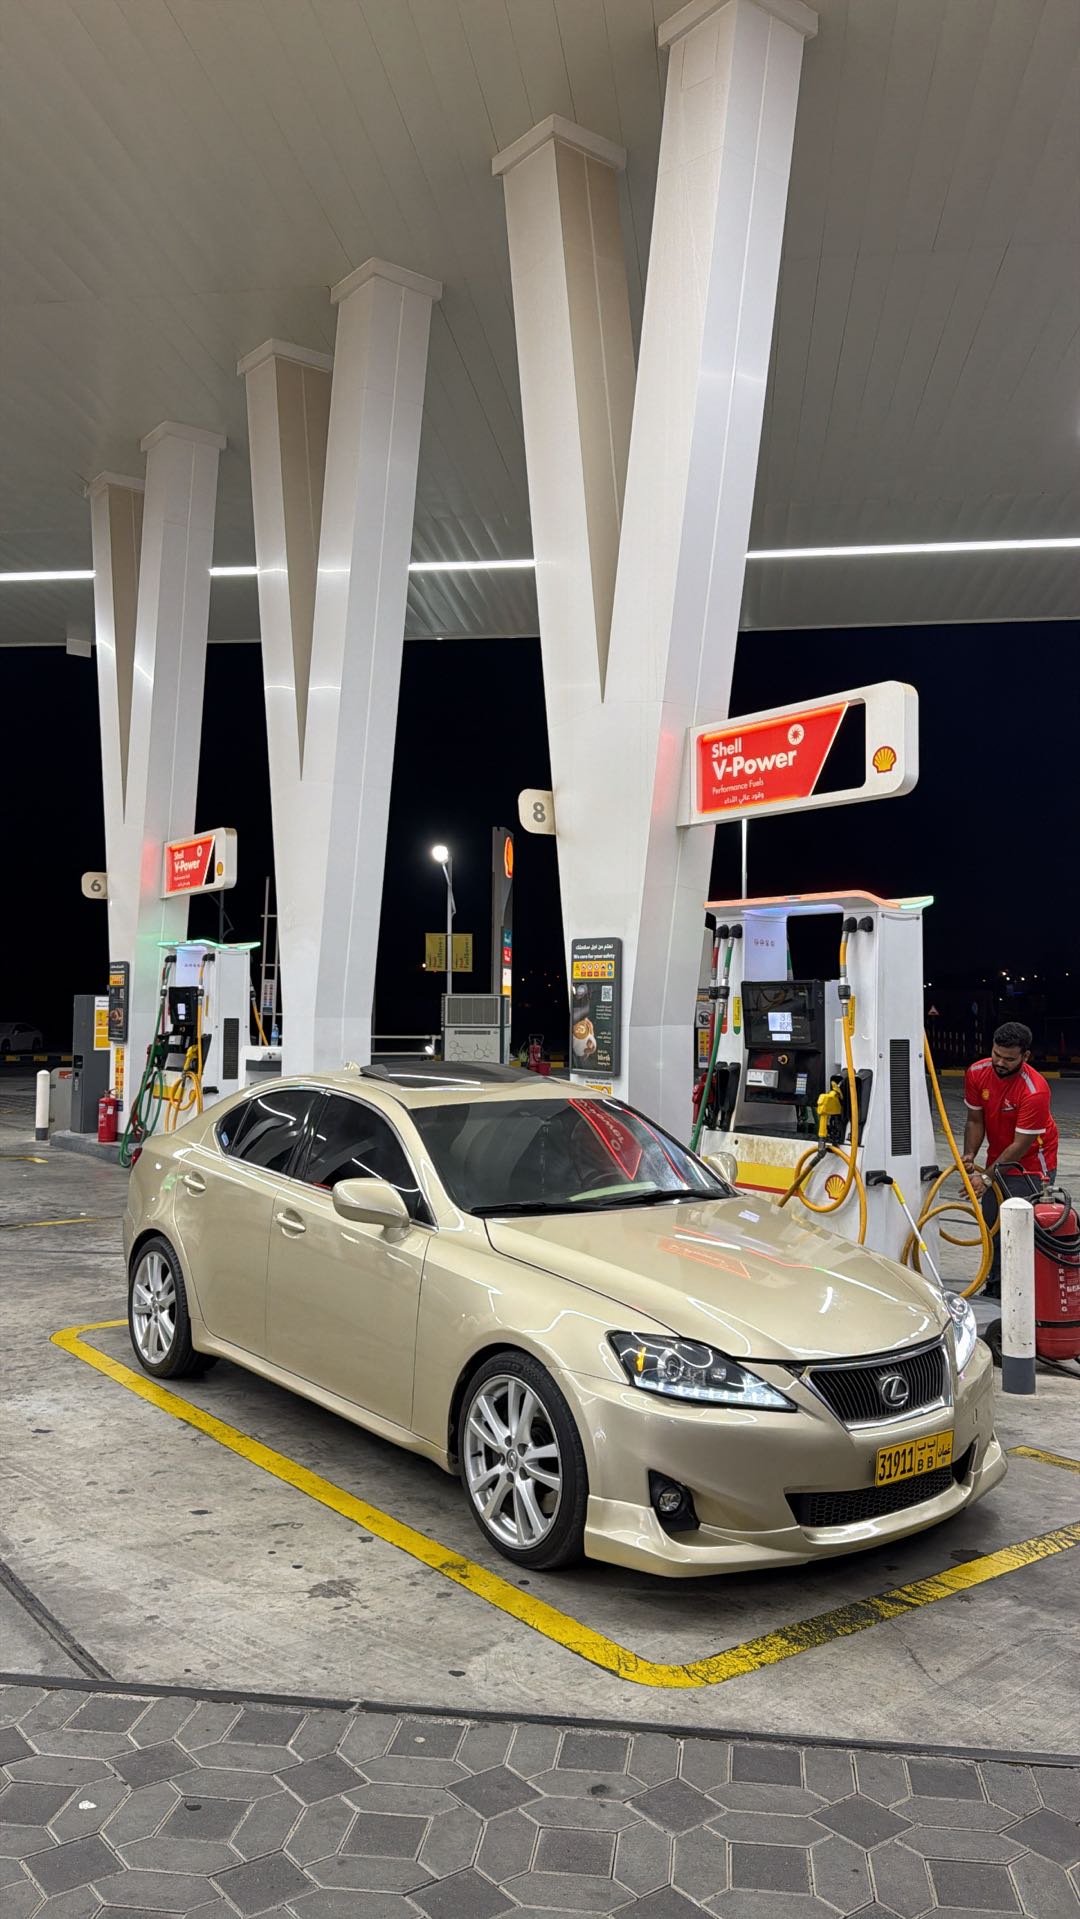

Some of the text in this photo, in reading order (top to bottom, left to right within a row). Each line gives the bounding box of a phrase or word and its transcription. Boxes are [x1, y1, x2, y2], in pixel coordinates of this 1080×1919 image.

[711, 736, 742, 758] Shell
[711, 750, 798, 781] V-Power
[711, 777, 764, 795] Performance Fuels
[533, 801, 546, 823] 8
[174, 860, 200, 873] V-Power
[91, 879, 102, 893] 6
[879, 1446, 914, 1481] 31911
[917, 1455, 934, 1472] B B
